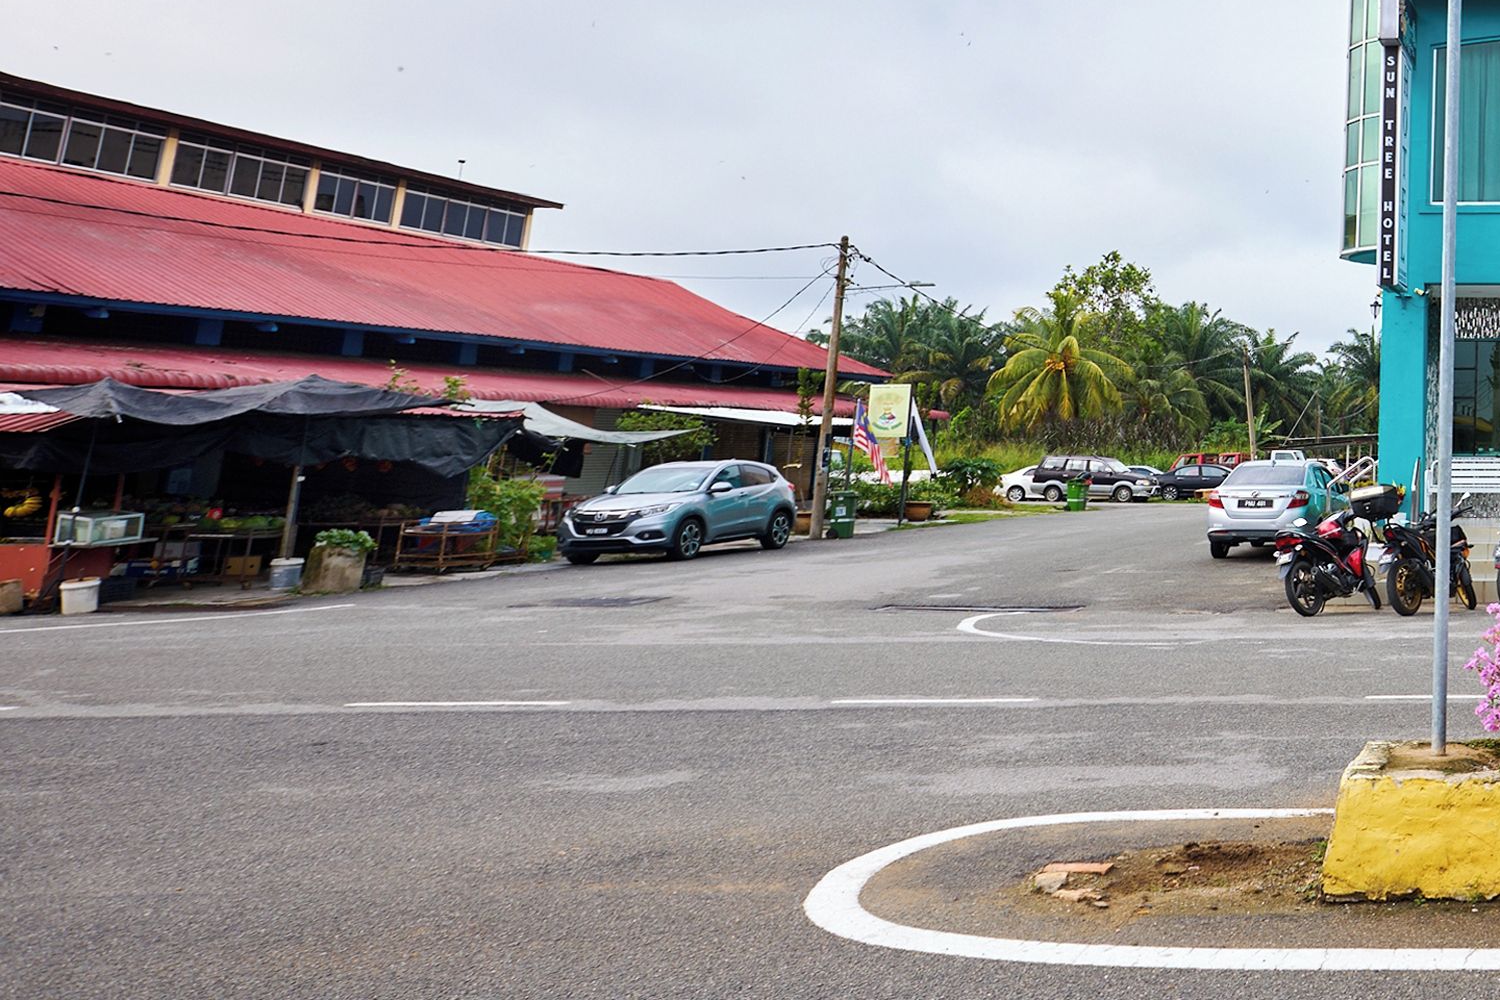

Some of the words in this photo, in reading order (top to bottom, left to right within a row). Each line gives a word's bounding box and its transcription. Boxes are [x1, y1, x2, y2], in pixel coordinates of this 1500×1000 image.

[1385, 55, 1396, 99] SUN
[1384, 119, 1395, 179] TREE
[1382, 200, 1394, 279] HOTEL
